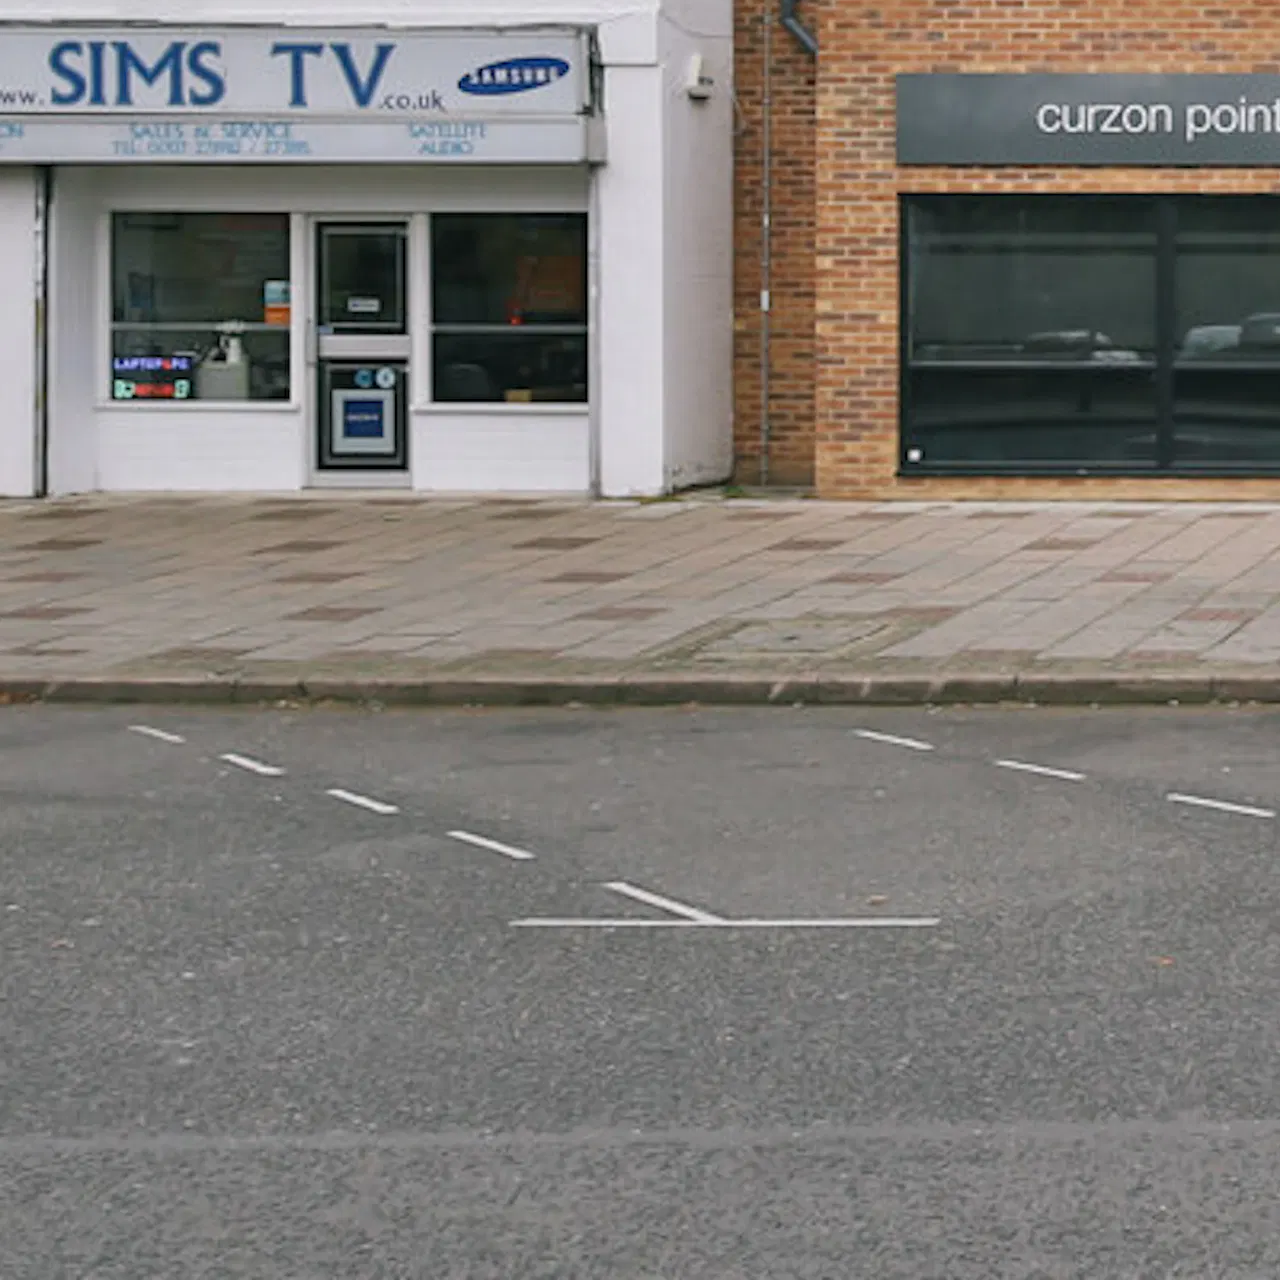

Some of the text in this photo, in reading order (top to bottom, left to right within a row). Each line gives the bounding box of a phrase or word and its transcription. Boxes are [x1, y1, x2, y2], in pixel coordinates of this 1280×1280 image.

[49, 40, 226, 107] SIMS
[270, 42, 397, 108] TV
[1036, 103, 1173, 133] curzon
